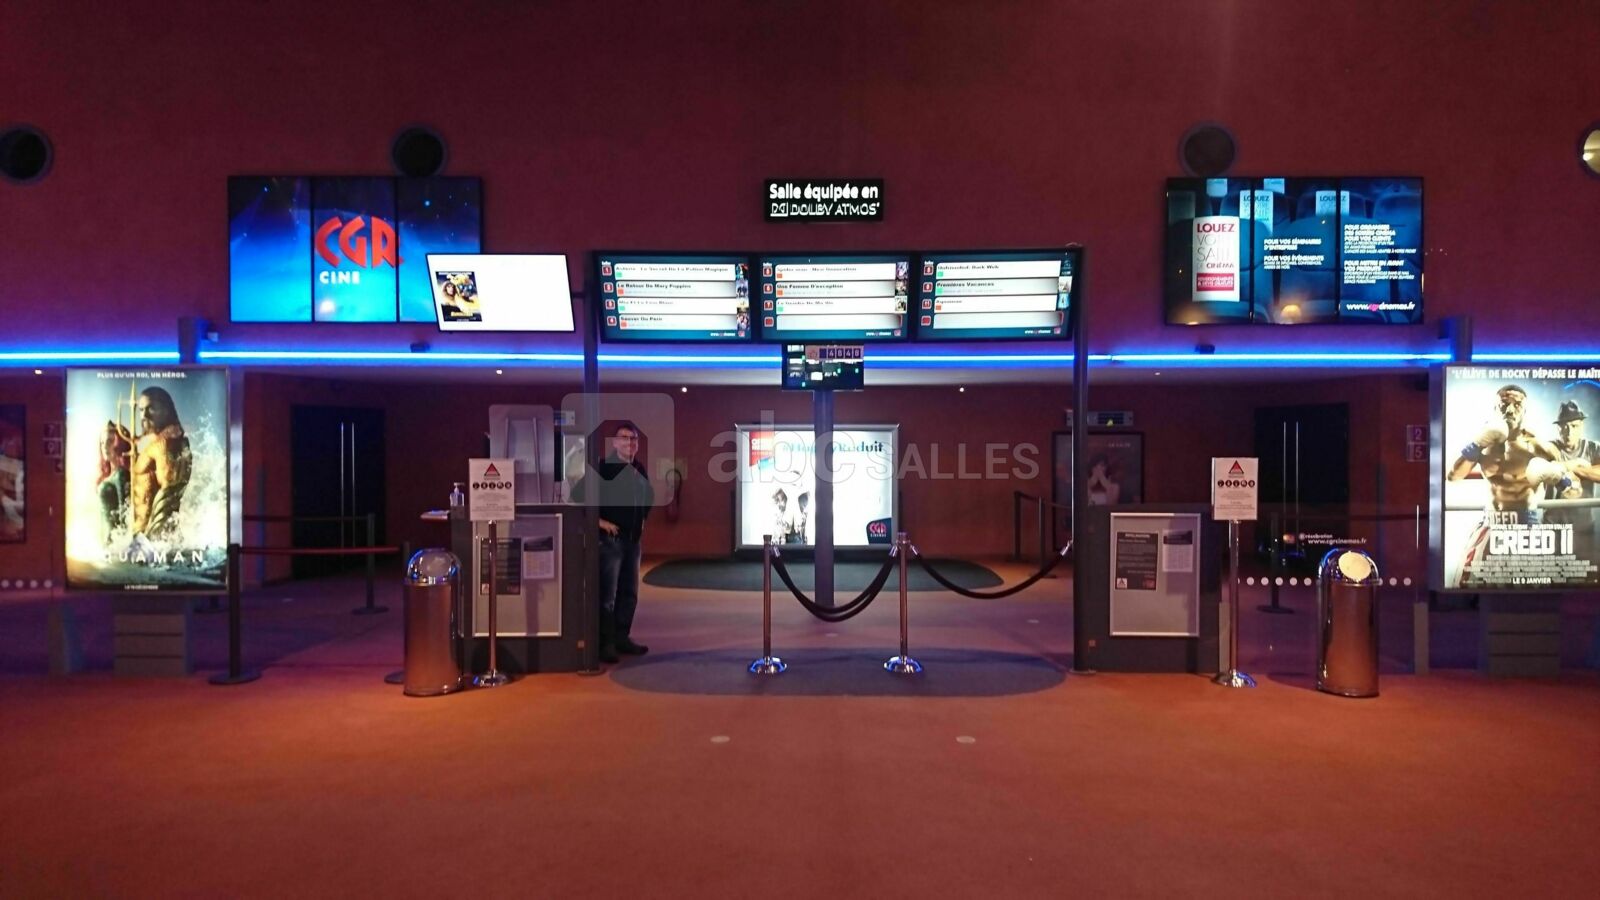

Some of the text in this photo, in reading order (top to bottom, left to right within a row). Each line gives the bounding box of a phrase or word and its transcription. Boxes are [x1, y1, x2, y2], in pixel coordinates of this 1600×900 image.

[769, 183, 878, 202] Salle équipée en
[834, 203, 877, 215] ATMOS
[1197, 223, 1235, 233] LOUEZ
[314, 215, 403, 269] CGR
[320, 271, 360, 284] CINE
[1488, 369, 1500, 379] DE
[1502, 369, 1530, 379] ROCKY
[1532, 367, 1565, 379] DÉPASSE
[1567, 369, 1576, 379] LE
[1489, 529, 1573, 555] CREED II
